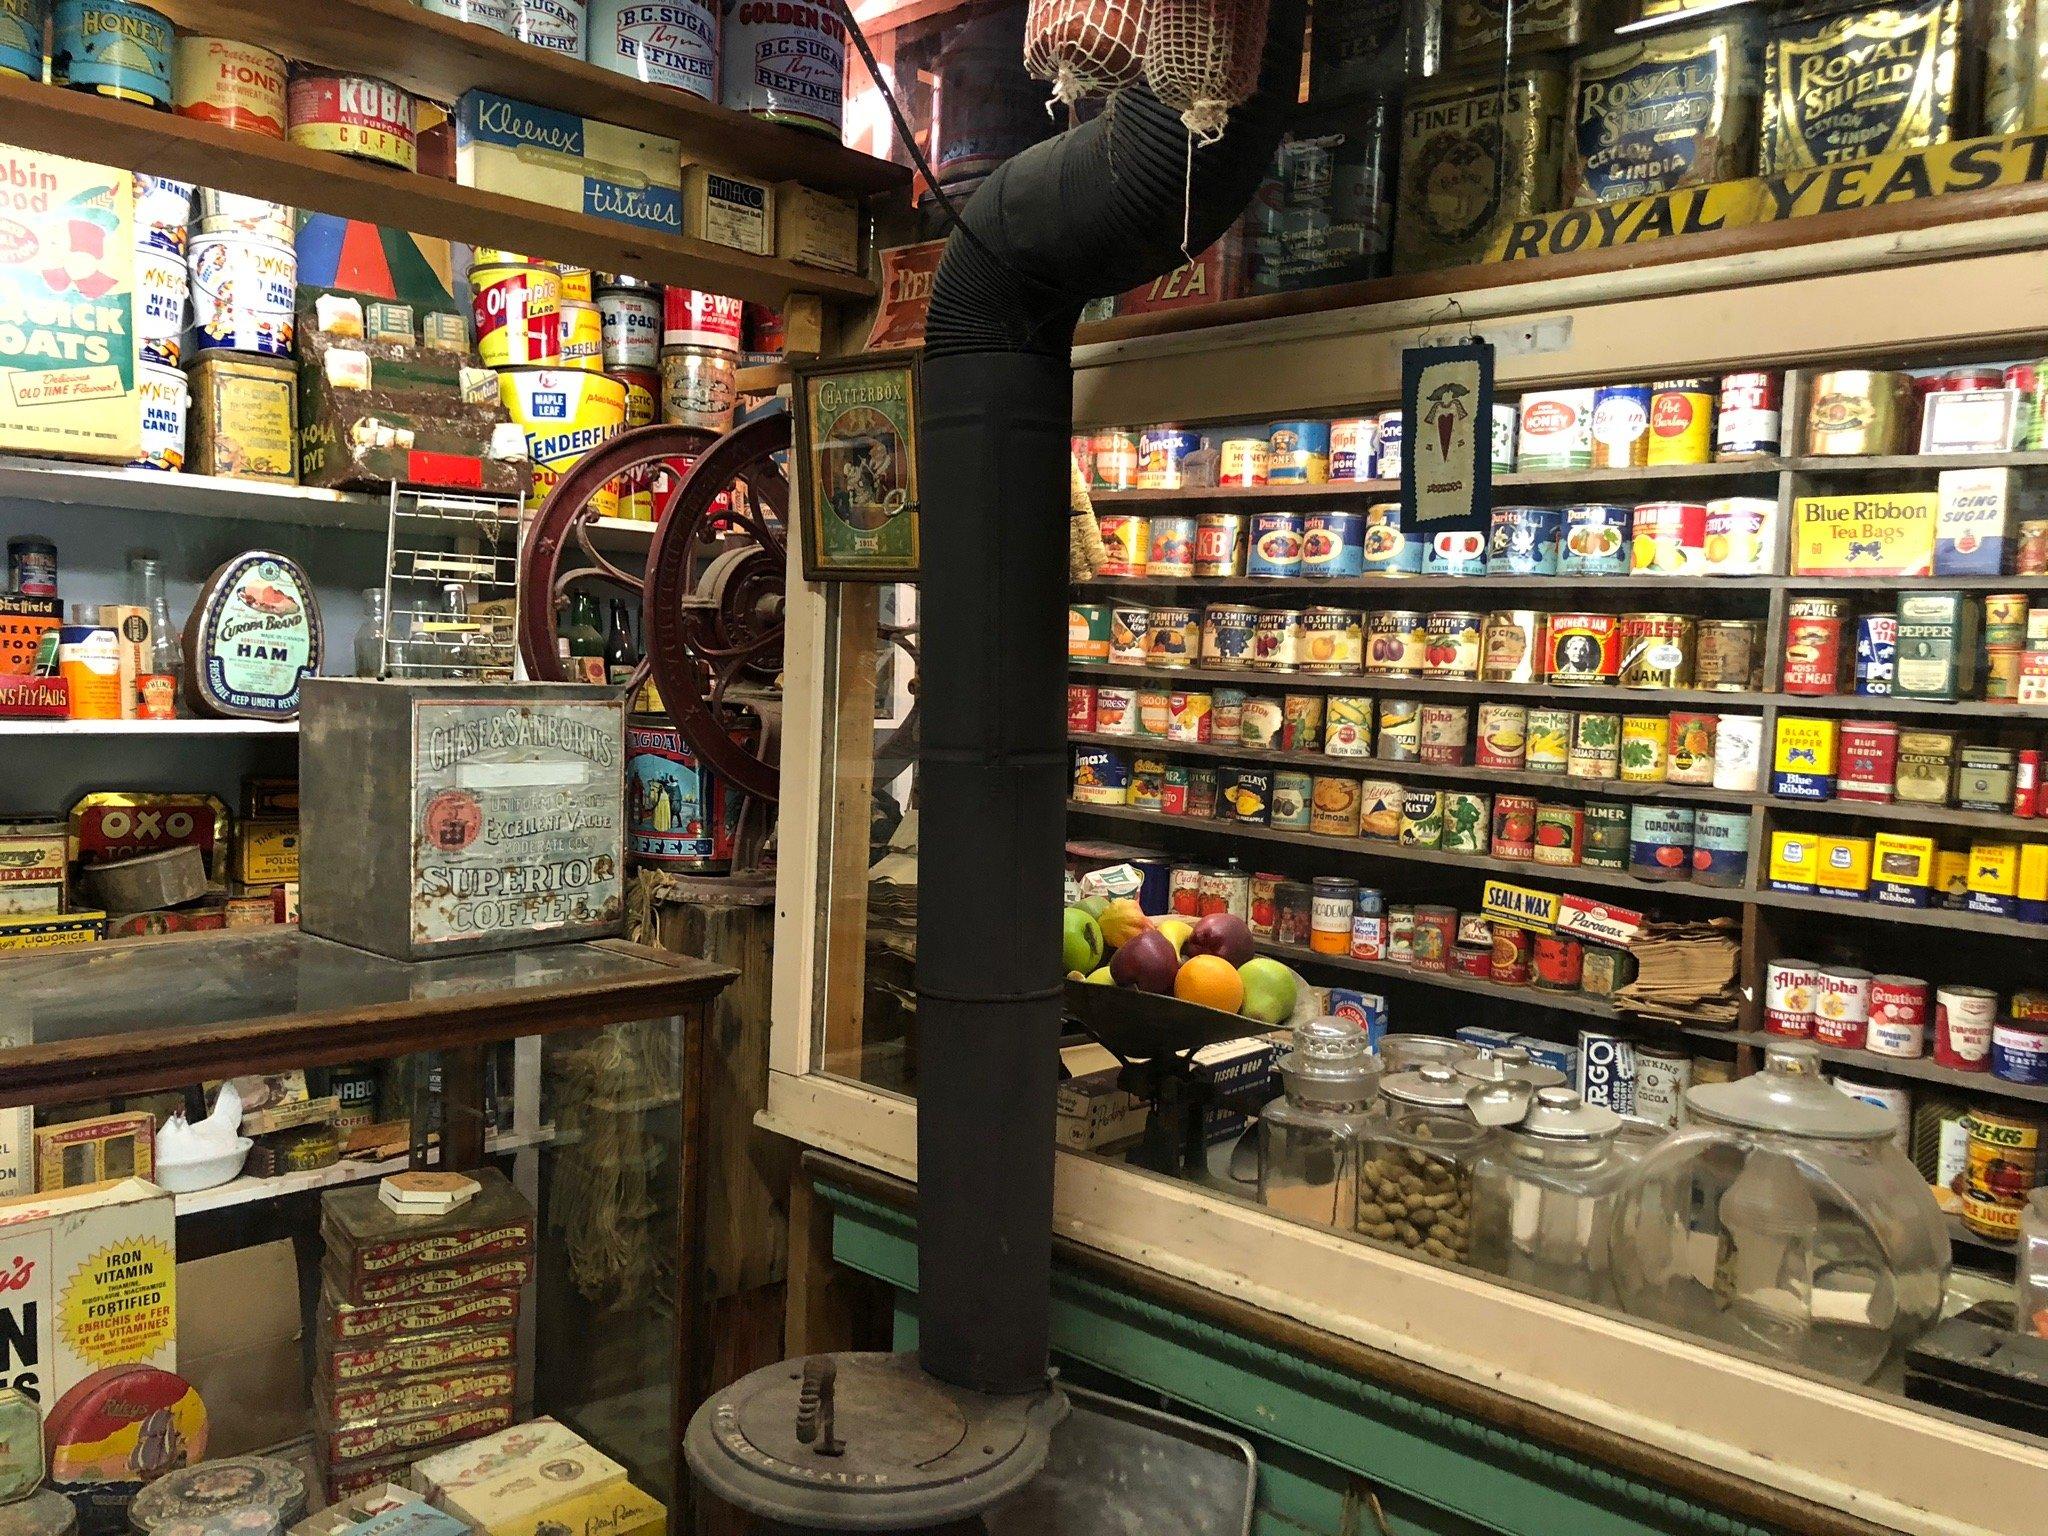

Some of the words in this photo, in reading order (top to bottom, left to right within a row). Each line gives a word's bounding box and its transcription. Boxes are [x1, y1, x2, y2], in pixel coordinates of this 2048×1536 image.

[740, 2, 819, 30] GOLDEN
[82, 9, 166, 54] HONEY
[221, 63, 284, 96] HONEY
[1798, 40, 1918, 101] ROYAL
[1581, 65, 1716, 125] ROYAL
[1805, 63, 1916, 121] SHIELD
[478, 100, 582, 154] Kleenex
[1412, 106, 1460, 137] FINE
[708, 176, 764, 208] AMACO
[585, 181, 681, 227] tissues
[1502, 188, 1728, 262] ROYAL
[535, 394, 564, 406] MAPLE
[819, 380, 902, 412] CHATTERBOX
[147, 407, 177, 422] HARD
[143, 419, 180, 435] CANDY
[1804, 502, 1850, 523] Blue
[1853, 501, 1928, 521] Ribbon
[1942, 509, 1998, 523] SUGAR
[1829, 524, 1858, 539] Tea
[1861, 523, 1905, 544] Bags
[265, 614, 303, 632] BRAND
[1312, 623, 1338, 631] PURE
[1898, 625, 1953, 637] PEPPER
[236, 643, 289, 662] HAM
[1631, 670, 1664, 683] JAM
[1804, 673, 1832, 685] MEAT
[230, 693, 250, 706] KEEP
[251, 695, 276, 708] UNDER
[1785, 727, 1820, 738] BLACK
[1781, 738, 1823, 748] PEPPER
[1846, 747, 1884, 757] RIBBON
[1854, 738, 1877, 748] BLUE
[1901, 754, 1946, 765] CLOVES
[1786, 773, 1814, 785] Blue
[1778, 781, 1820, 797] Ribbon
[1404, 802, 1429, 814] KIST
[101, 810, 194, 840] OXO
[484, 815, 562, 843] EXCELLENT
[567, 810, 612, 832] VALUE
[421, 853, 614, 898] SUPERIOR
[1878, 890, 1917, 905] Ribbon
[1886, 883, 1911, 895] Blue
[1974, 892, 1999, 904] Blue
[1967, 901, 2005, 914] Ribbon
[1354, 927, 1378, 937] Moore
[1355, 919, 1377, 930] Dinty
[1569, 910, 1624, 938] Parowax
[25, 931, 87, 945] LIQUORICE
[1781, 1019, 1808, 1031] MILK
[1817, 1025, 1843, 1038] MILK
[1213, 1064, 1241, 1085] TISSUE
[1612, 1080, 1620, 1112] GLOSS
[1637, 1090, 1669, 1104] COCOA
[1982, 1207, 2017, 1225] JUICE
[432, 1241, 478, 1259] BRIGHT
[481, 1228, 517, 1244] GUMS
[106, 1249, 142, 1268] IRON
[94, 1262, 154, 1285] VITAMIN
[431, 1273, 477, 1292] BRIGHT
[481, 1261, 517, 1277] GUMS
[88, 1291, 161, 1318] FORTIFIED
[134, 1312, 146, 1322] de
[150, 1305, 171, 1318] FER
[414, 1309, 460, 1327] BRIGHT
[465, 1297, 501, 1313] GUMS
[109, 1317, 169, 1339] VITAMINES
